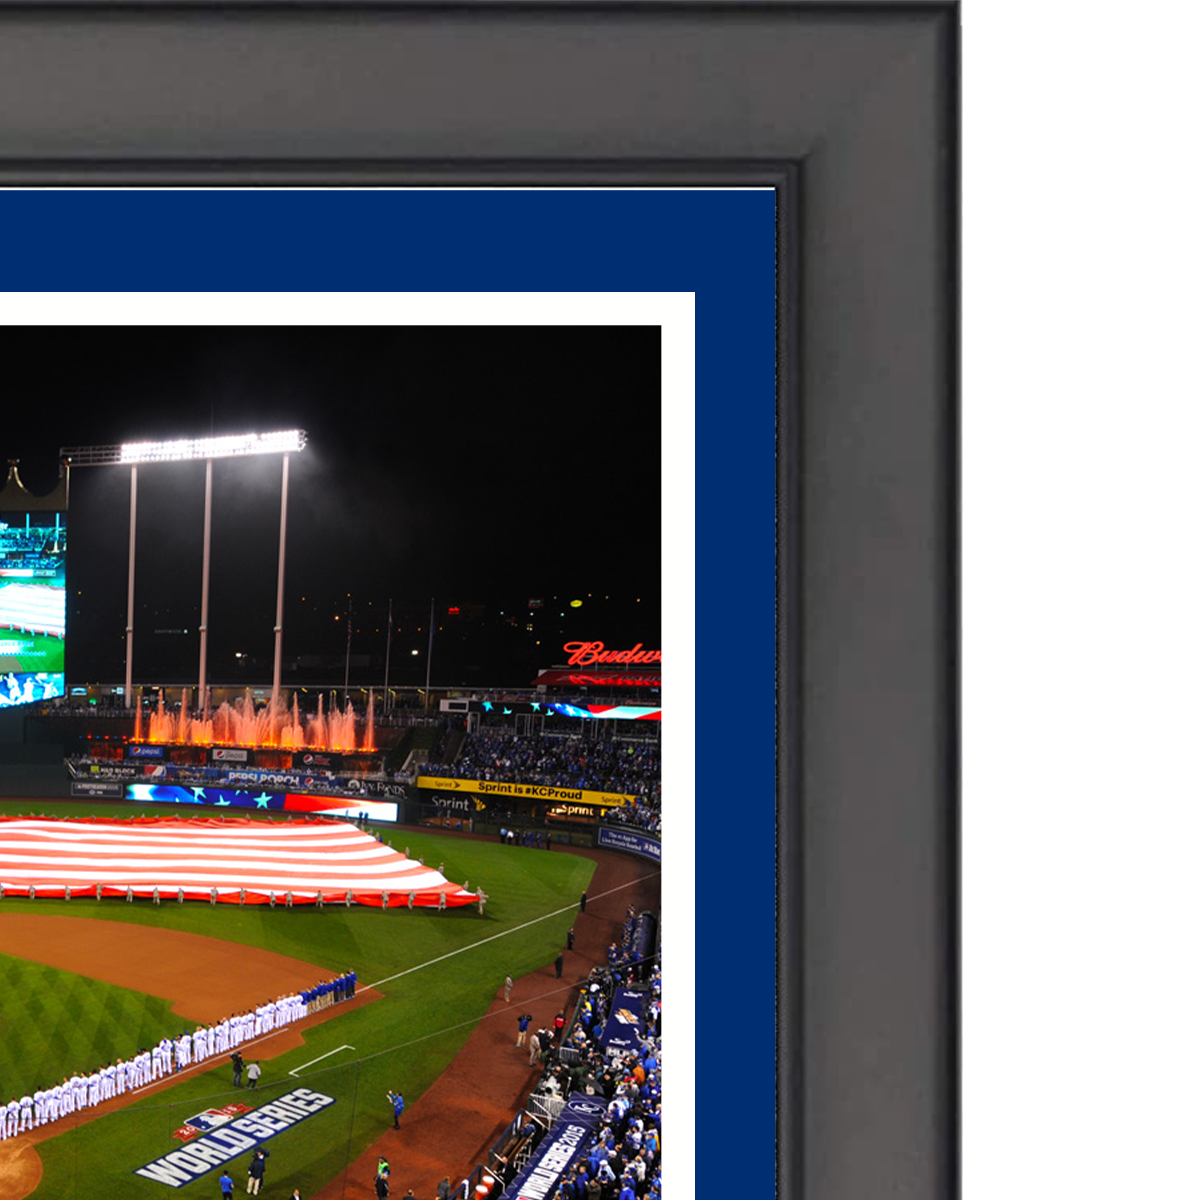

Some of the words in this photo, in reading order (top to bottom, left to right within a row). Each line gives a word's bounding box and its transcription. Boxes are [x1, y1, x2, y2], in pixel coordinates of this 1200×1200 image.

[478, 782, 512, 794] Sprint
[514, 784, 523, 794] is
[525, 785, 583, 800] #KCProud
[432, 796, 470, 811] Sprint
[134, 1127, 259, 1189] WORLD
[230, 1087, 336, 1139] SERIES
[558, 1124, 587, 1148] 2015
